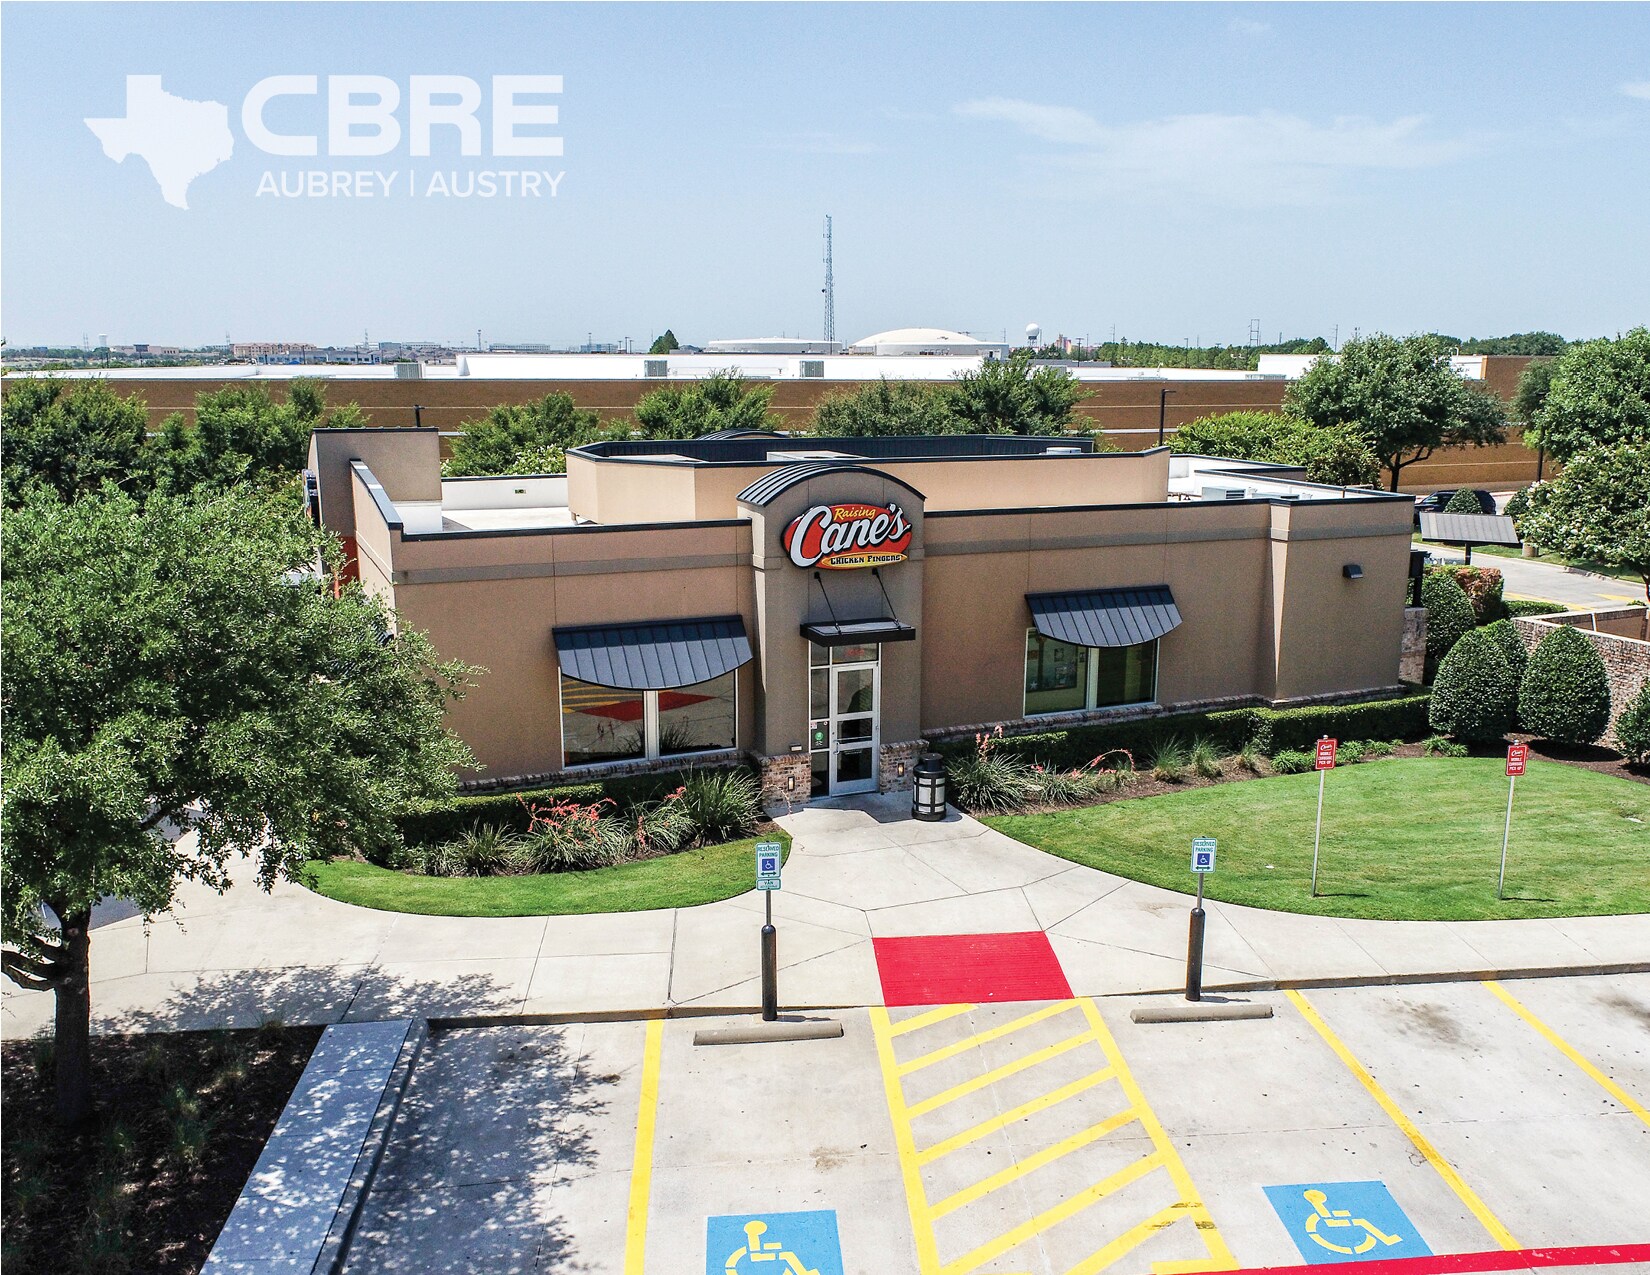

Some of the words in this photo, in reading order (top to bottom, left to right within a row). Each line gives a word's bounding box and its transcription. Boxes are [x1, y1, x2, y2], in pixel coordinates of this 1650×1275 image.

[834, 507, 876, 520] Raising
[790, 503, 911, 567] Cane's
[830, 557, 865, 565] CHICKEN
